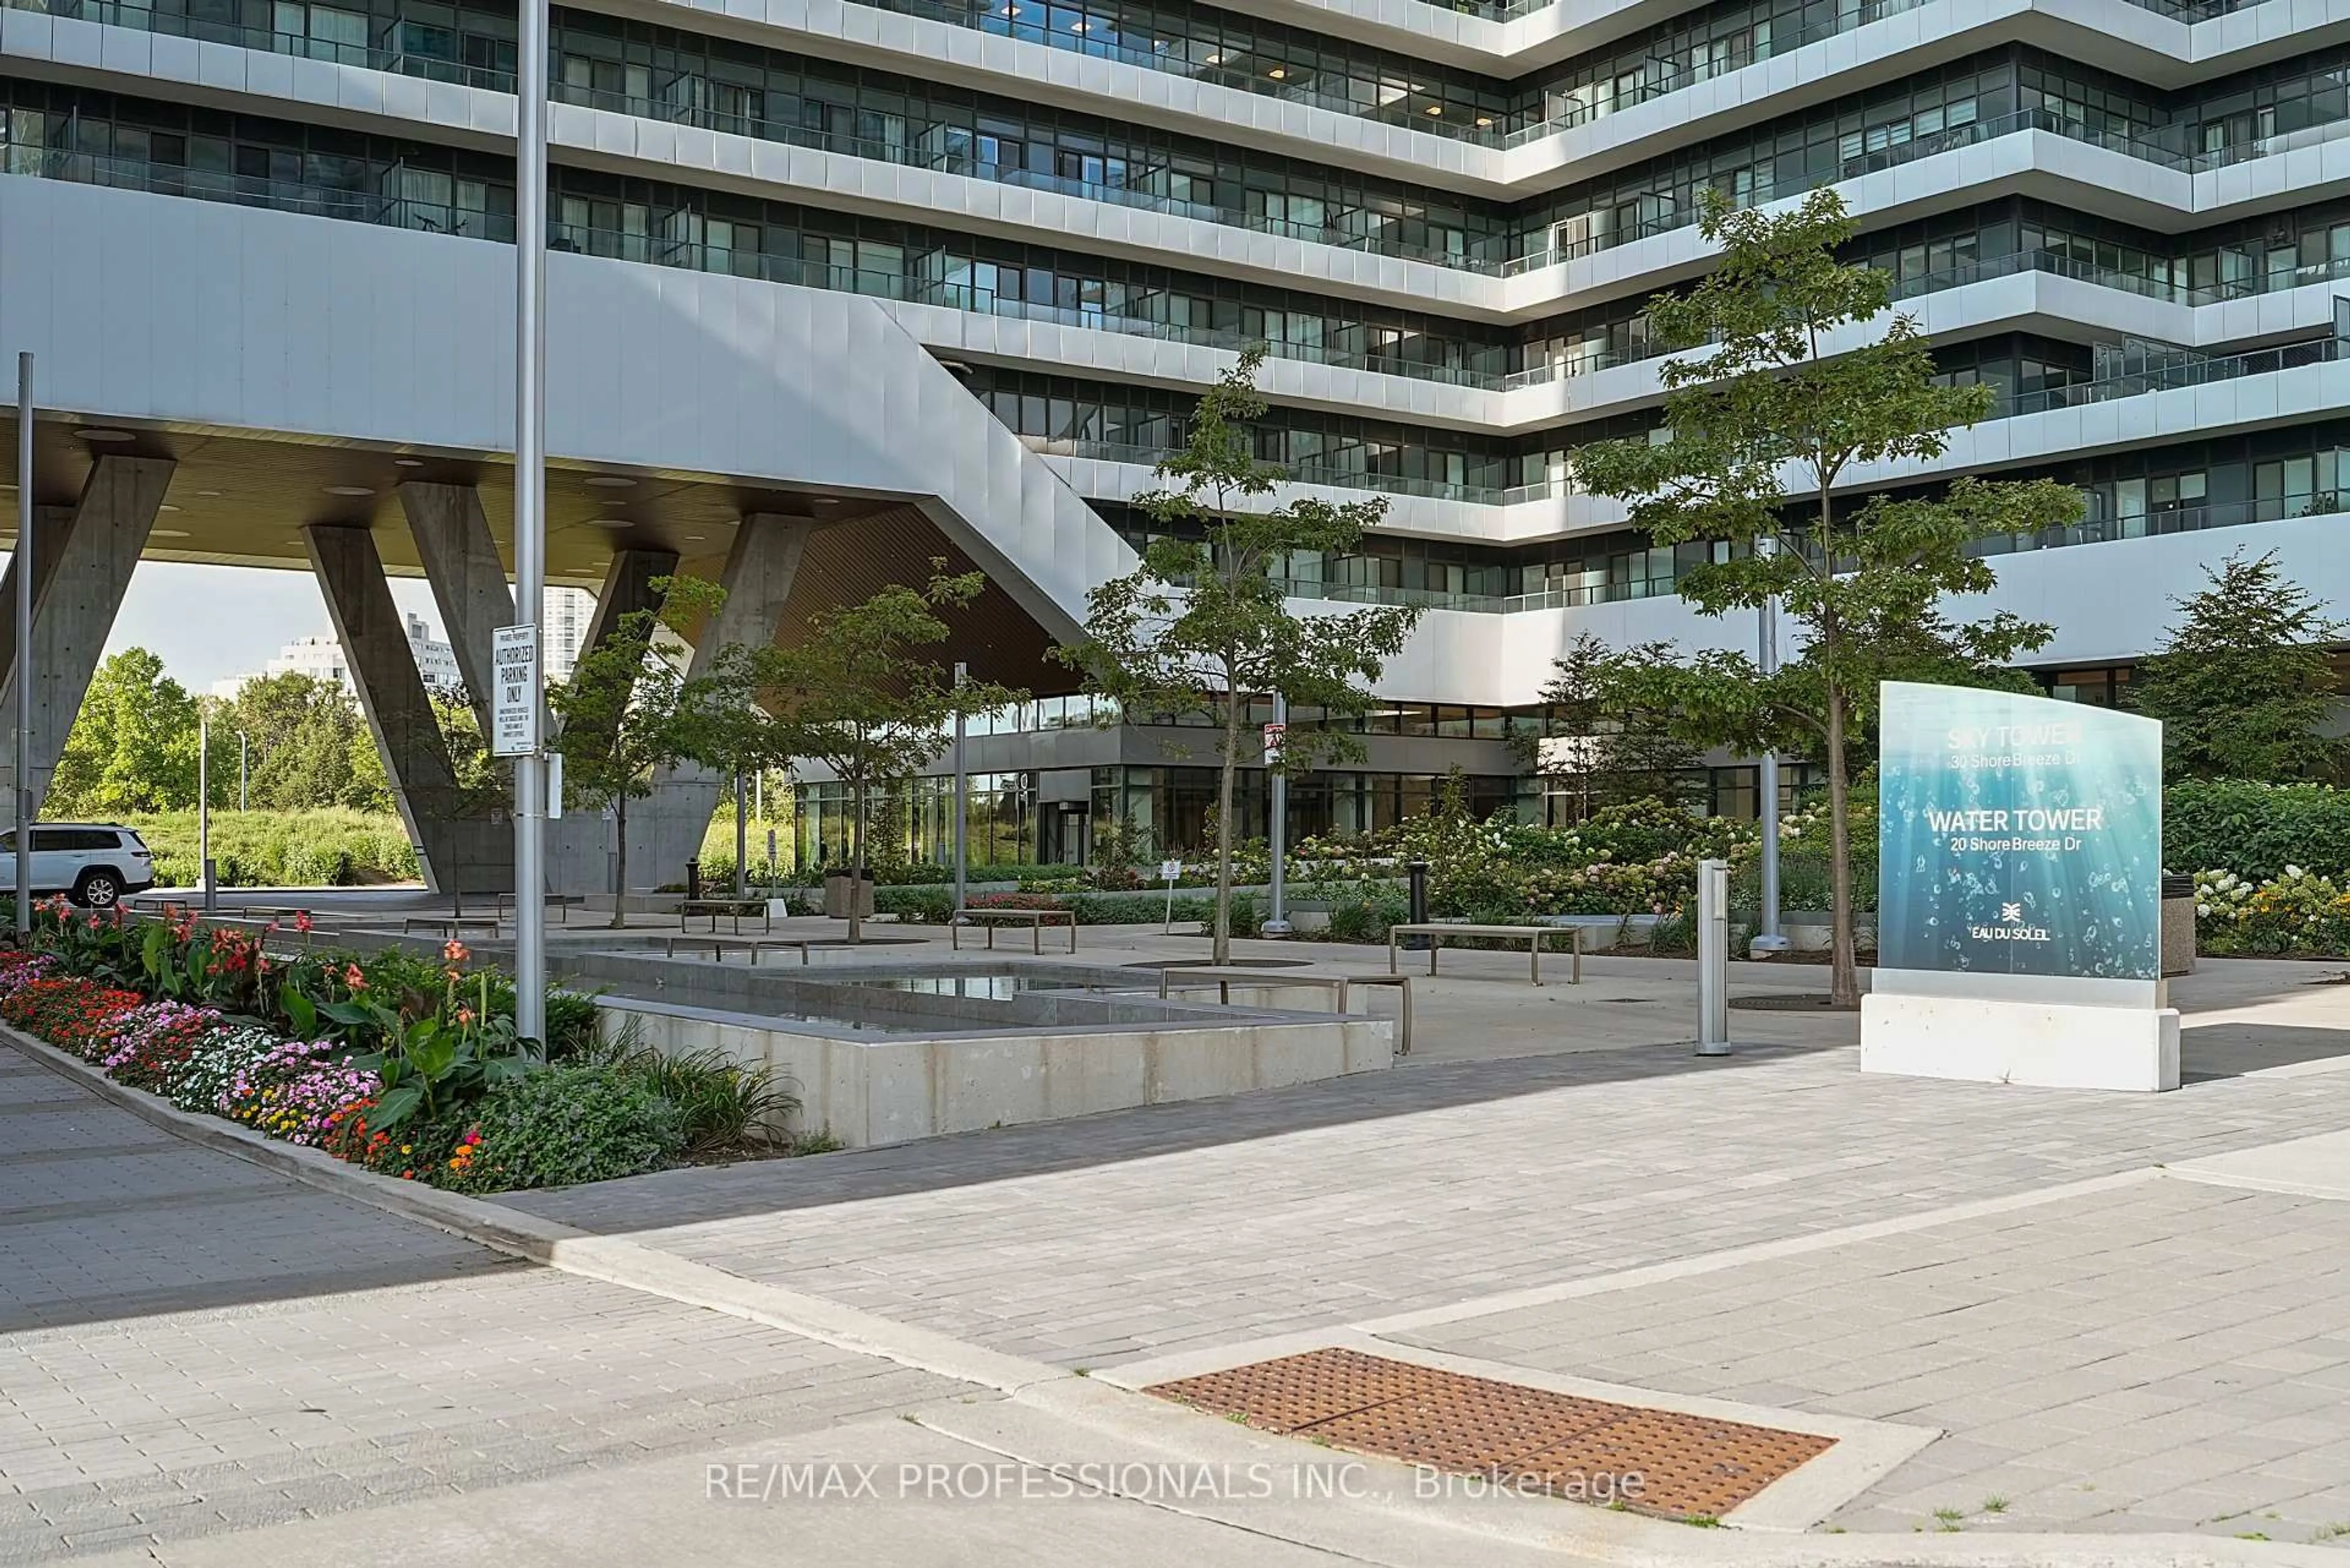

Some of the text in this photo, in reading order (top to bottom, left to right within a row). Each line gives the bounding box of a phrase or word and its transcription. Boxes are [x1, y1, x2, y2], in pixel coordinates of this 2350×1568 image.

[496, 644, 534, 665] AUTHORIZED
[501, 665, 528, 684] PARKING
[507, 685, 522, 703] ONLY
[1997, 723, 2083, 747] TOWE
[1950, 755, 1968, 769] 30
[1928, 808, 2102, 832] WATER TOWER
[1950, 837, 1967, 851] 20
[2064, 837, 2082, 851] Dr
[1972, 927, 2051, 941] EAU DU SOLEIL
